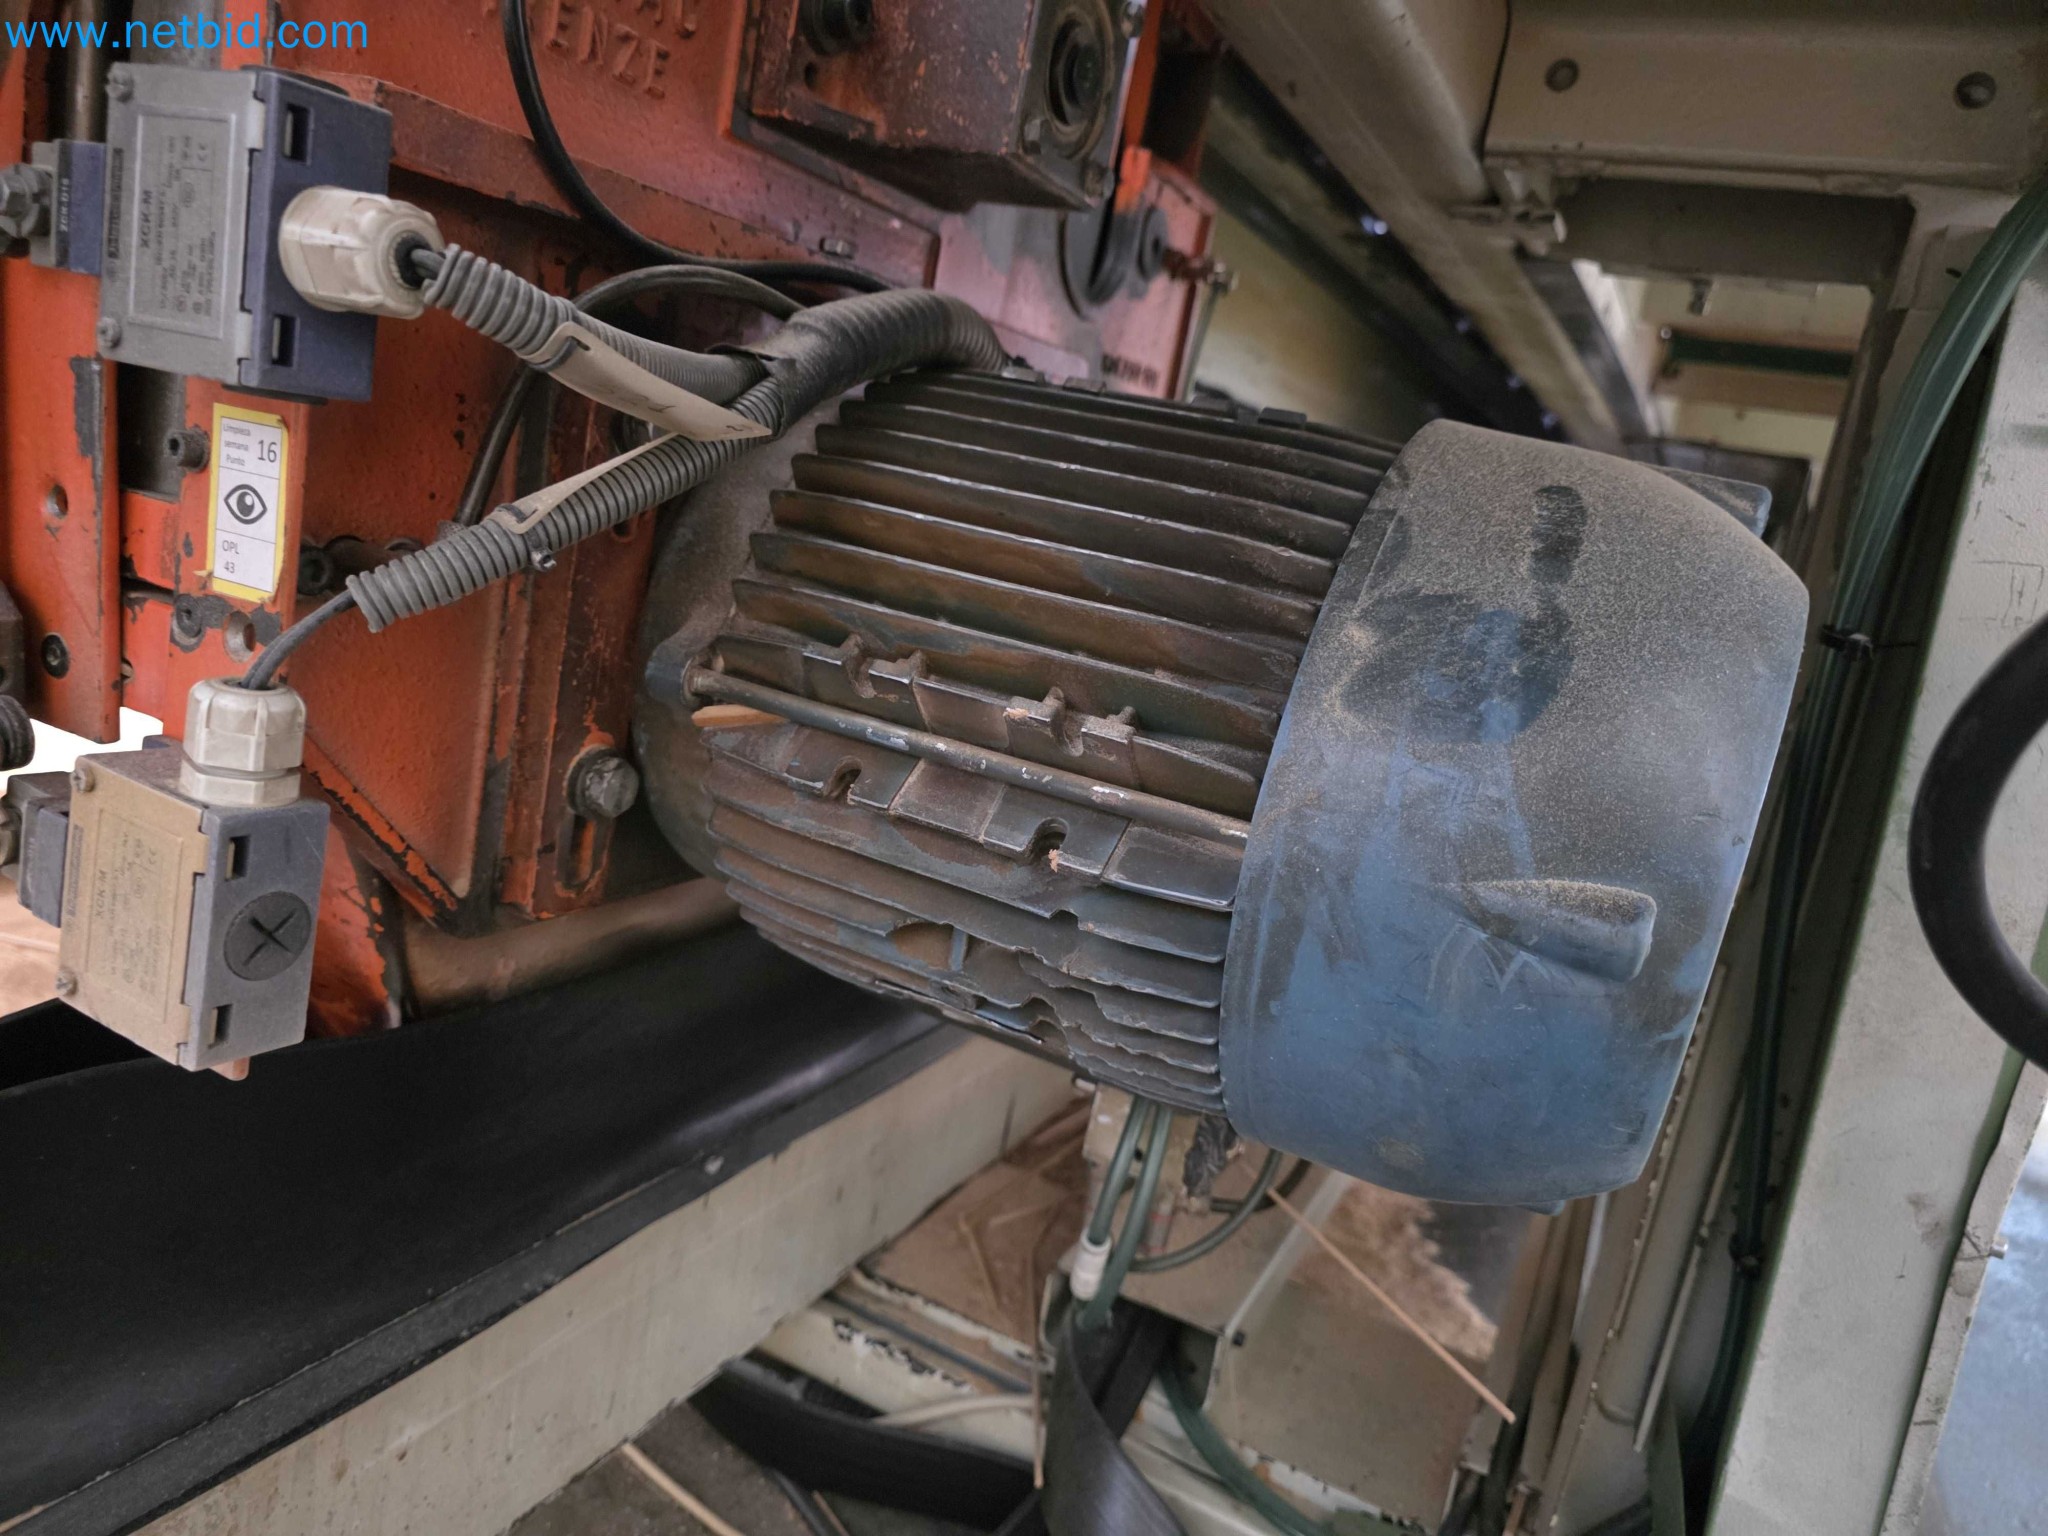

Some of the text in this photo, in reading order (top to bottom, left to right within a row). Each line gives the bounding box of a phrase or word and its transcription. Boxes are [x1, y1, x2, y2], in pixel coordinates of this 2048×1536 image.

[224, 440, 249, 452] semana
[257, 440, 278, 463] 16
[226, 453, 246, 467] Punto
[222, 540, 240, 555] OPL
[224, 560, 235, 574] 43
